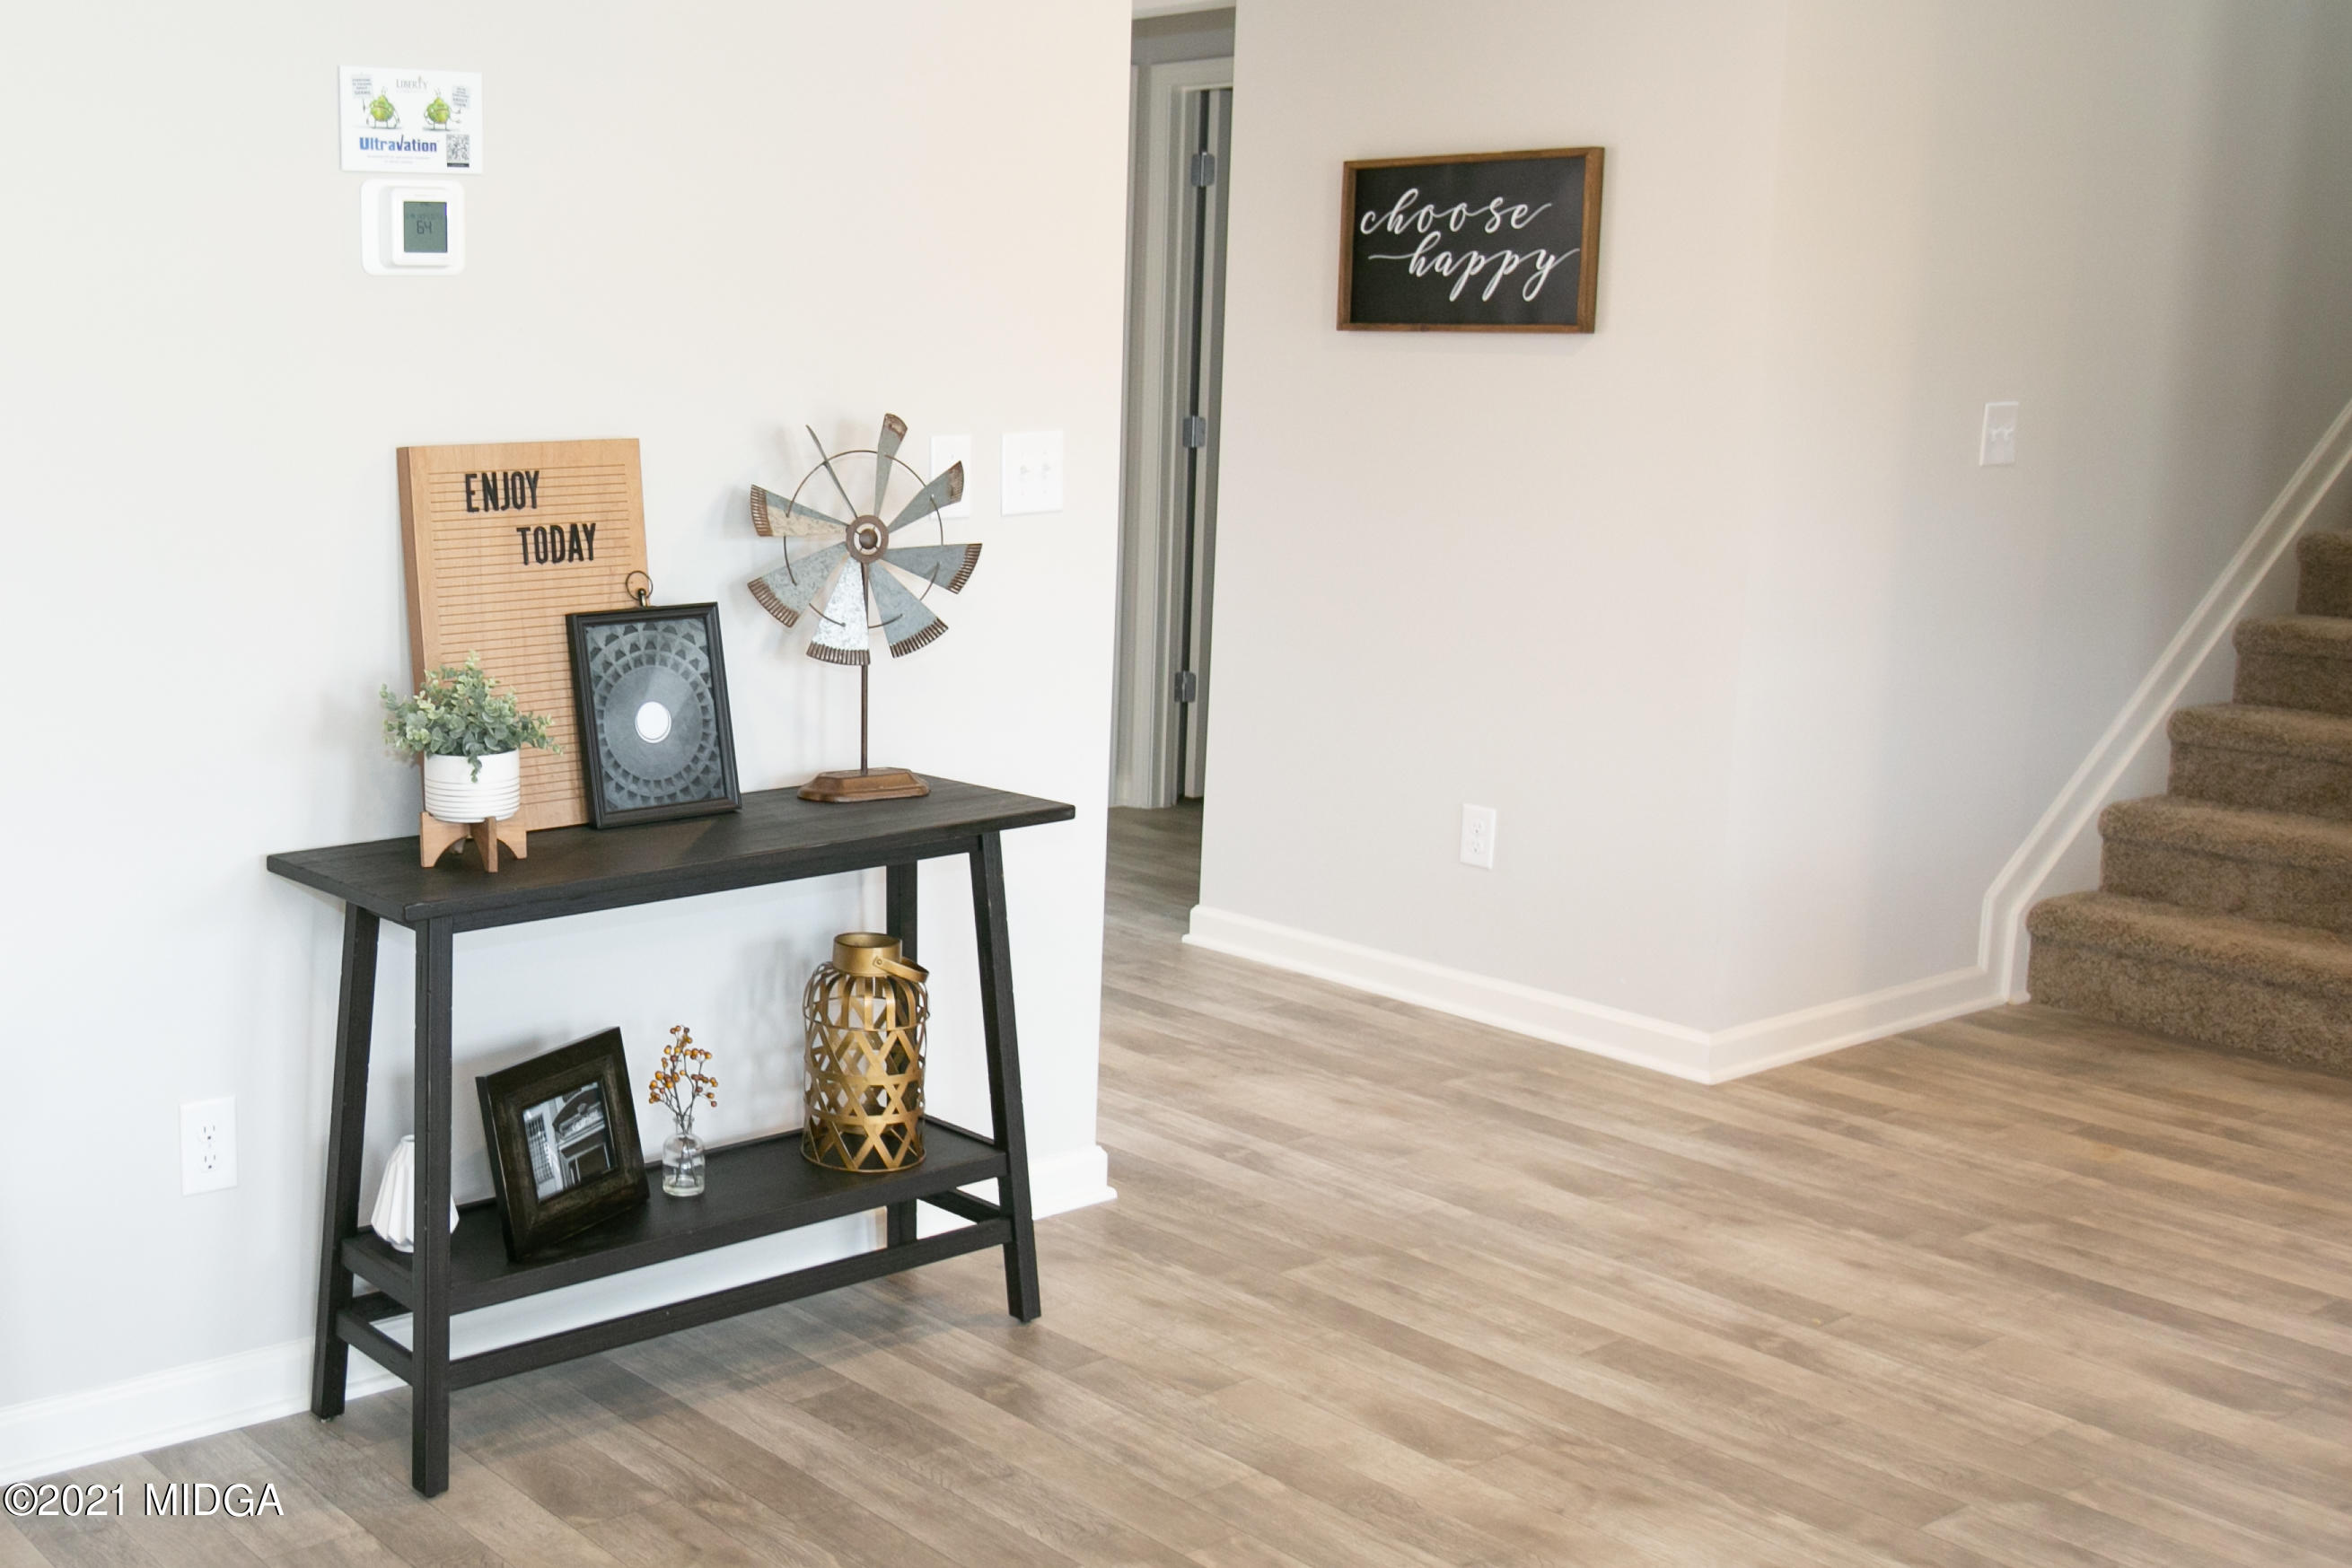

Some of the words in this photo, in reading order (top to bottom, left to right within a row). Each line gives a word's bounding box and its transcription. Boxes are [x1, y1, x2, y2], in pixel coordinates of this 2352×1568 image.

[396, 75, 428, 89] LIBERTY
[359, 134, 437, 152] Ultravation
[416, 219, 433, 234] 64
[1360, 188, 1552, 234] choose
[1368, 231, 1580, 302] happy
[465, 470, 540, 513] ENJOY
[516, 522, 596, 565] TODAY
